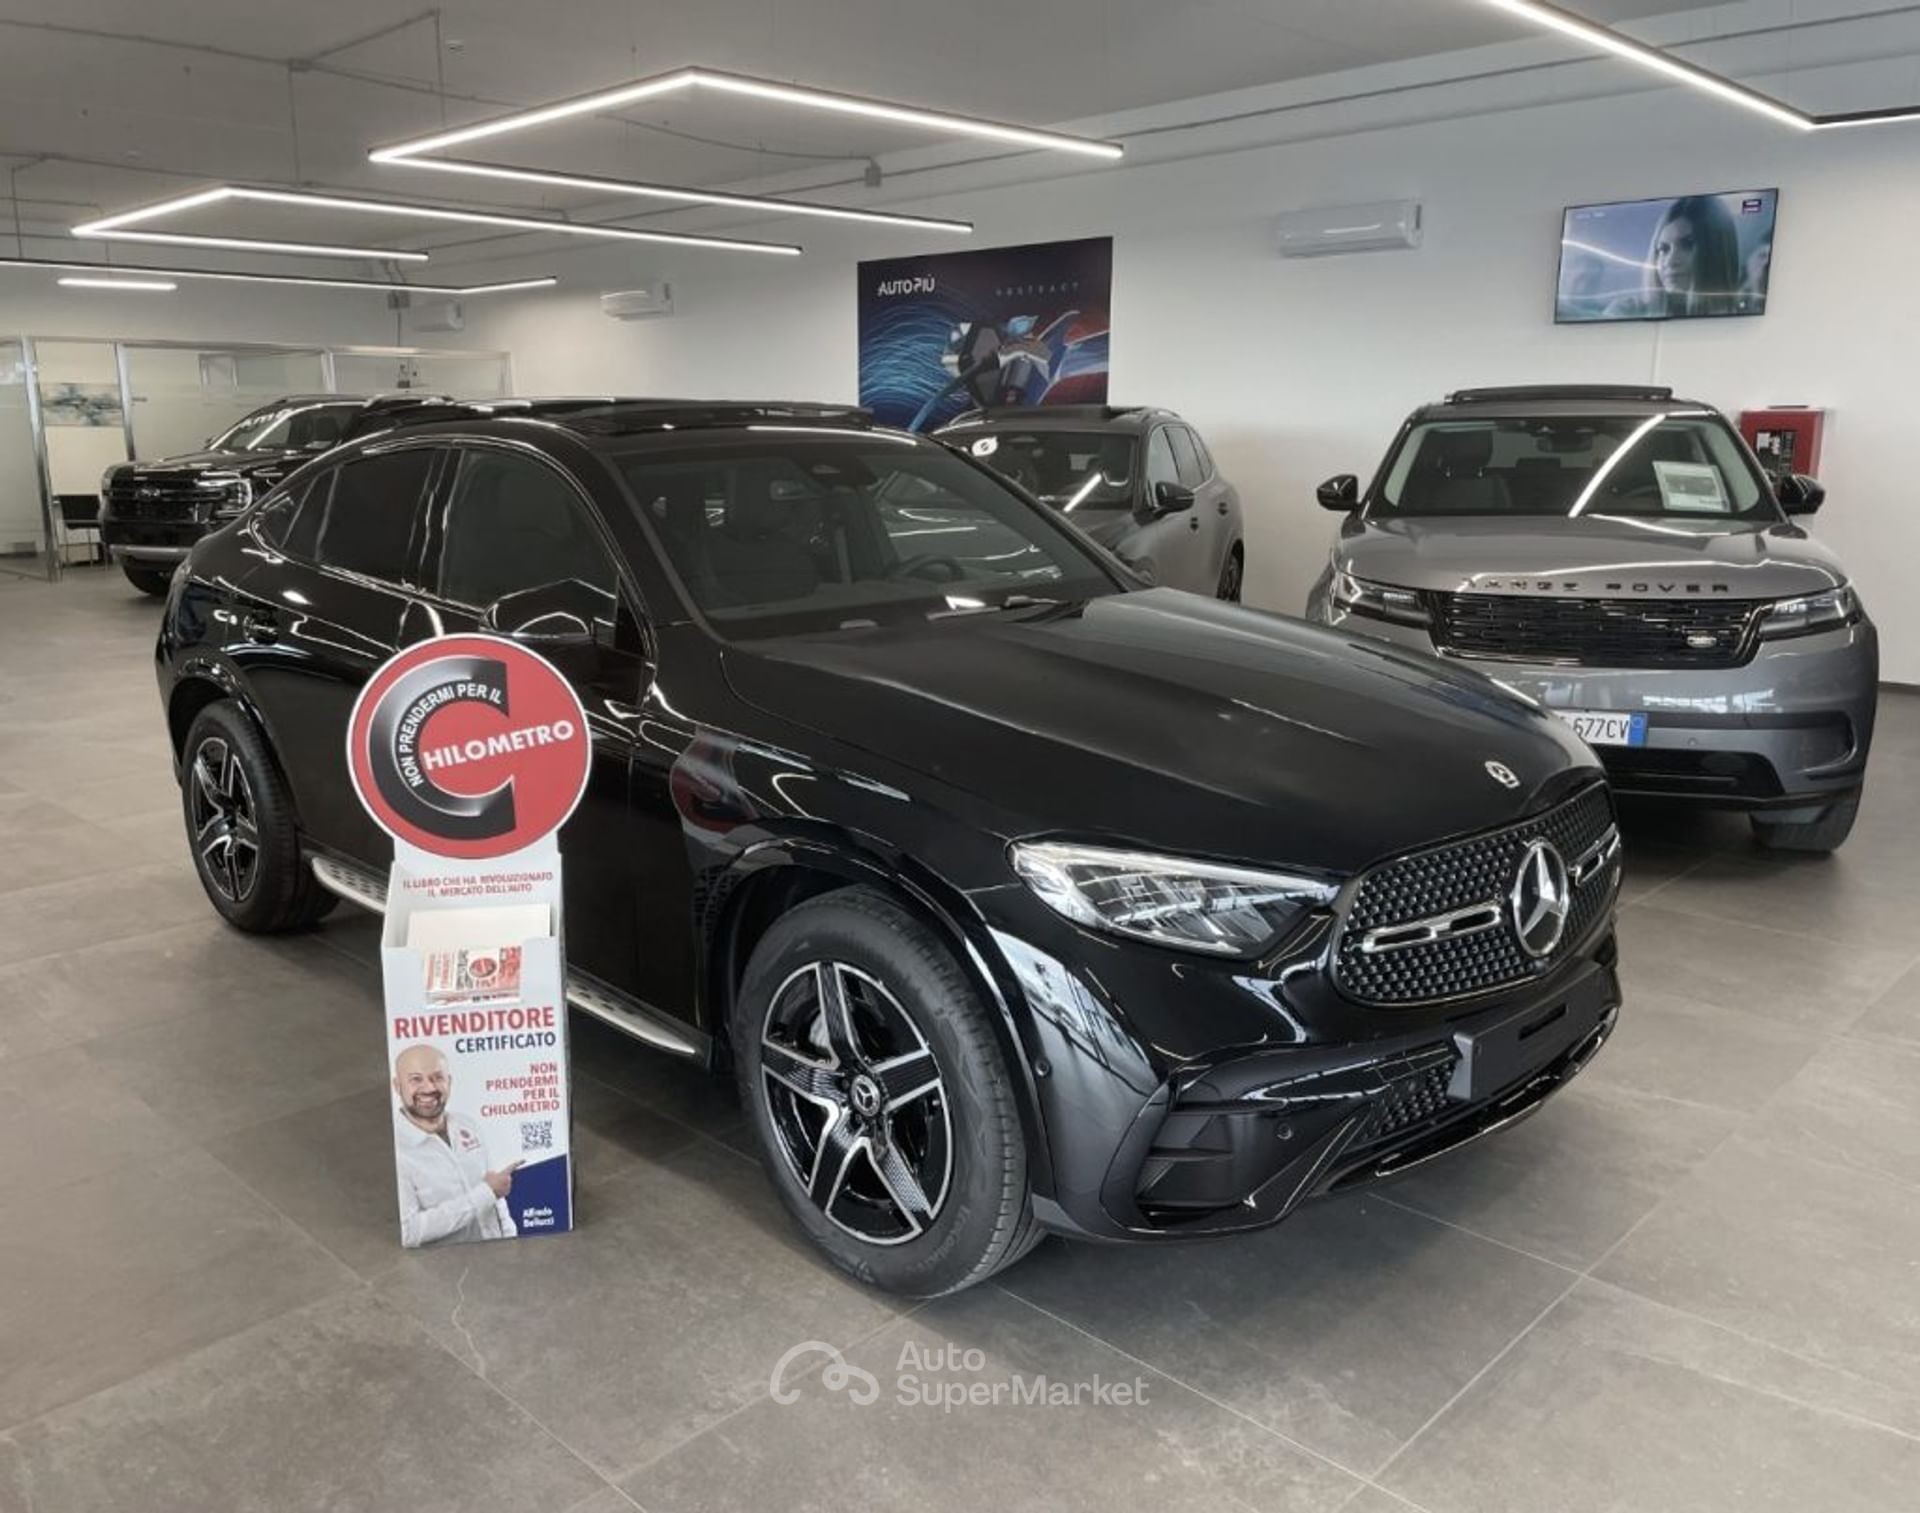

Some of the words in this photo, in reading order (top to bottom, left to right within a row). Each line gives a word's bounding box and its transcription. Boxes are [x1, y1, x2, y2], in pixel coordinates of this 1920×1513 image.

[1604, 582, 1730, 593] ROVER
[456, 682, 488, 699] PER
[488, 687, 503, 705] IL
[399, 686, 456, 753] PRENDERMI
[399, 756, 424, 788] NON
[413, 879, 441, 889] LIBRO
[442, 877, 461, 887] CHE
[463, 875, 476, 885] HA
[480, 871, 553, 884] RIVOLUZIONATO
[427, 889, 436, 898] IL
[440, 885, 484, 897] MERCATO
[394, 1007, 554, 1039] RIVENDITORE
[455, 1031, 556, 1054] CERTIFICATO
[530, 1062, 558, 1076] NON
[485, 1076, 558, 1091] PRENDERMI
[523, 1089, 547, 1101] PER
[550, 1089, 560, 1099] IL
[480, 1101, 559, 1117] CHILOMETRO
